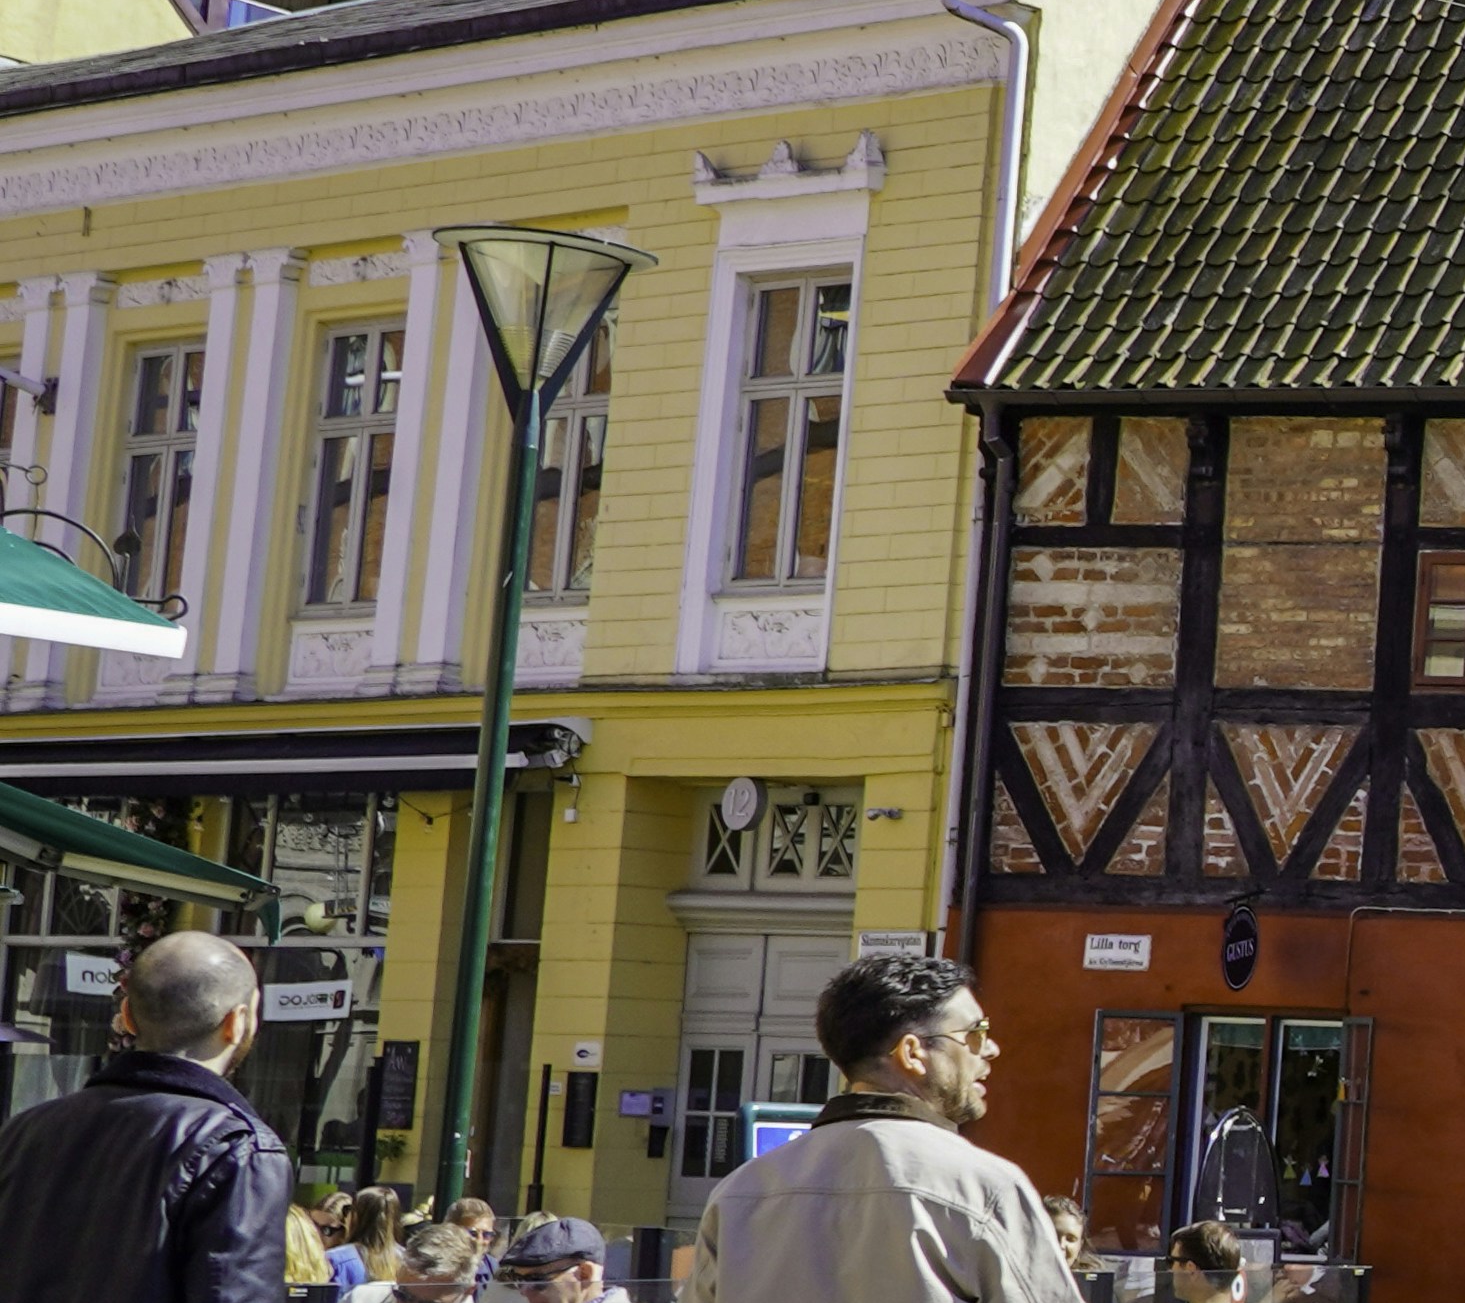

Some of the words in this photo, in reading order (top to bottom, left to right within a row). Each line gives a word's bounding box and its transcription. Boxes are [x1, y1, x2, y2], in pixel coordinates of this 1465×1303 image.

[729, 788, 750, 817] 12
[1090, 937, 1113, 950] Lilla
[1118, 938, 1142, 954] torg
